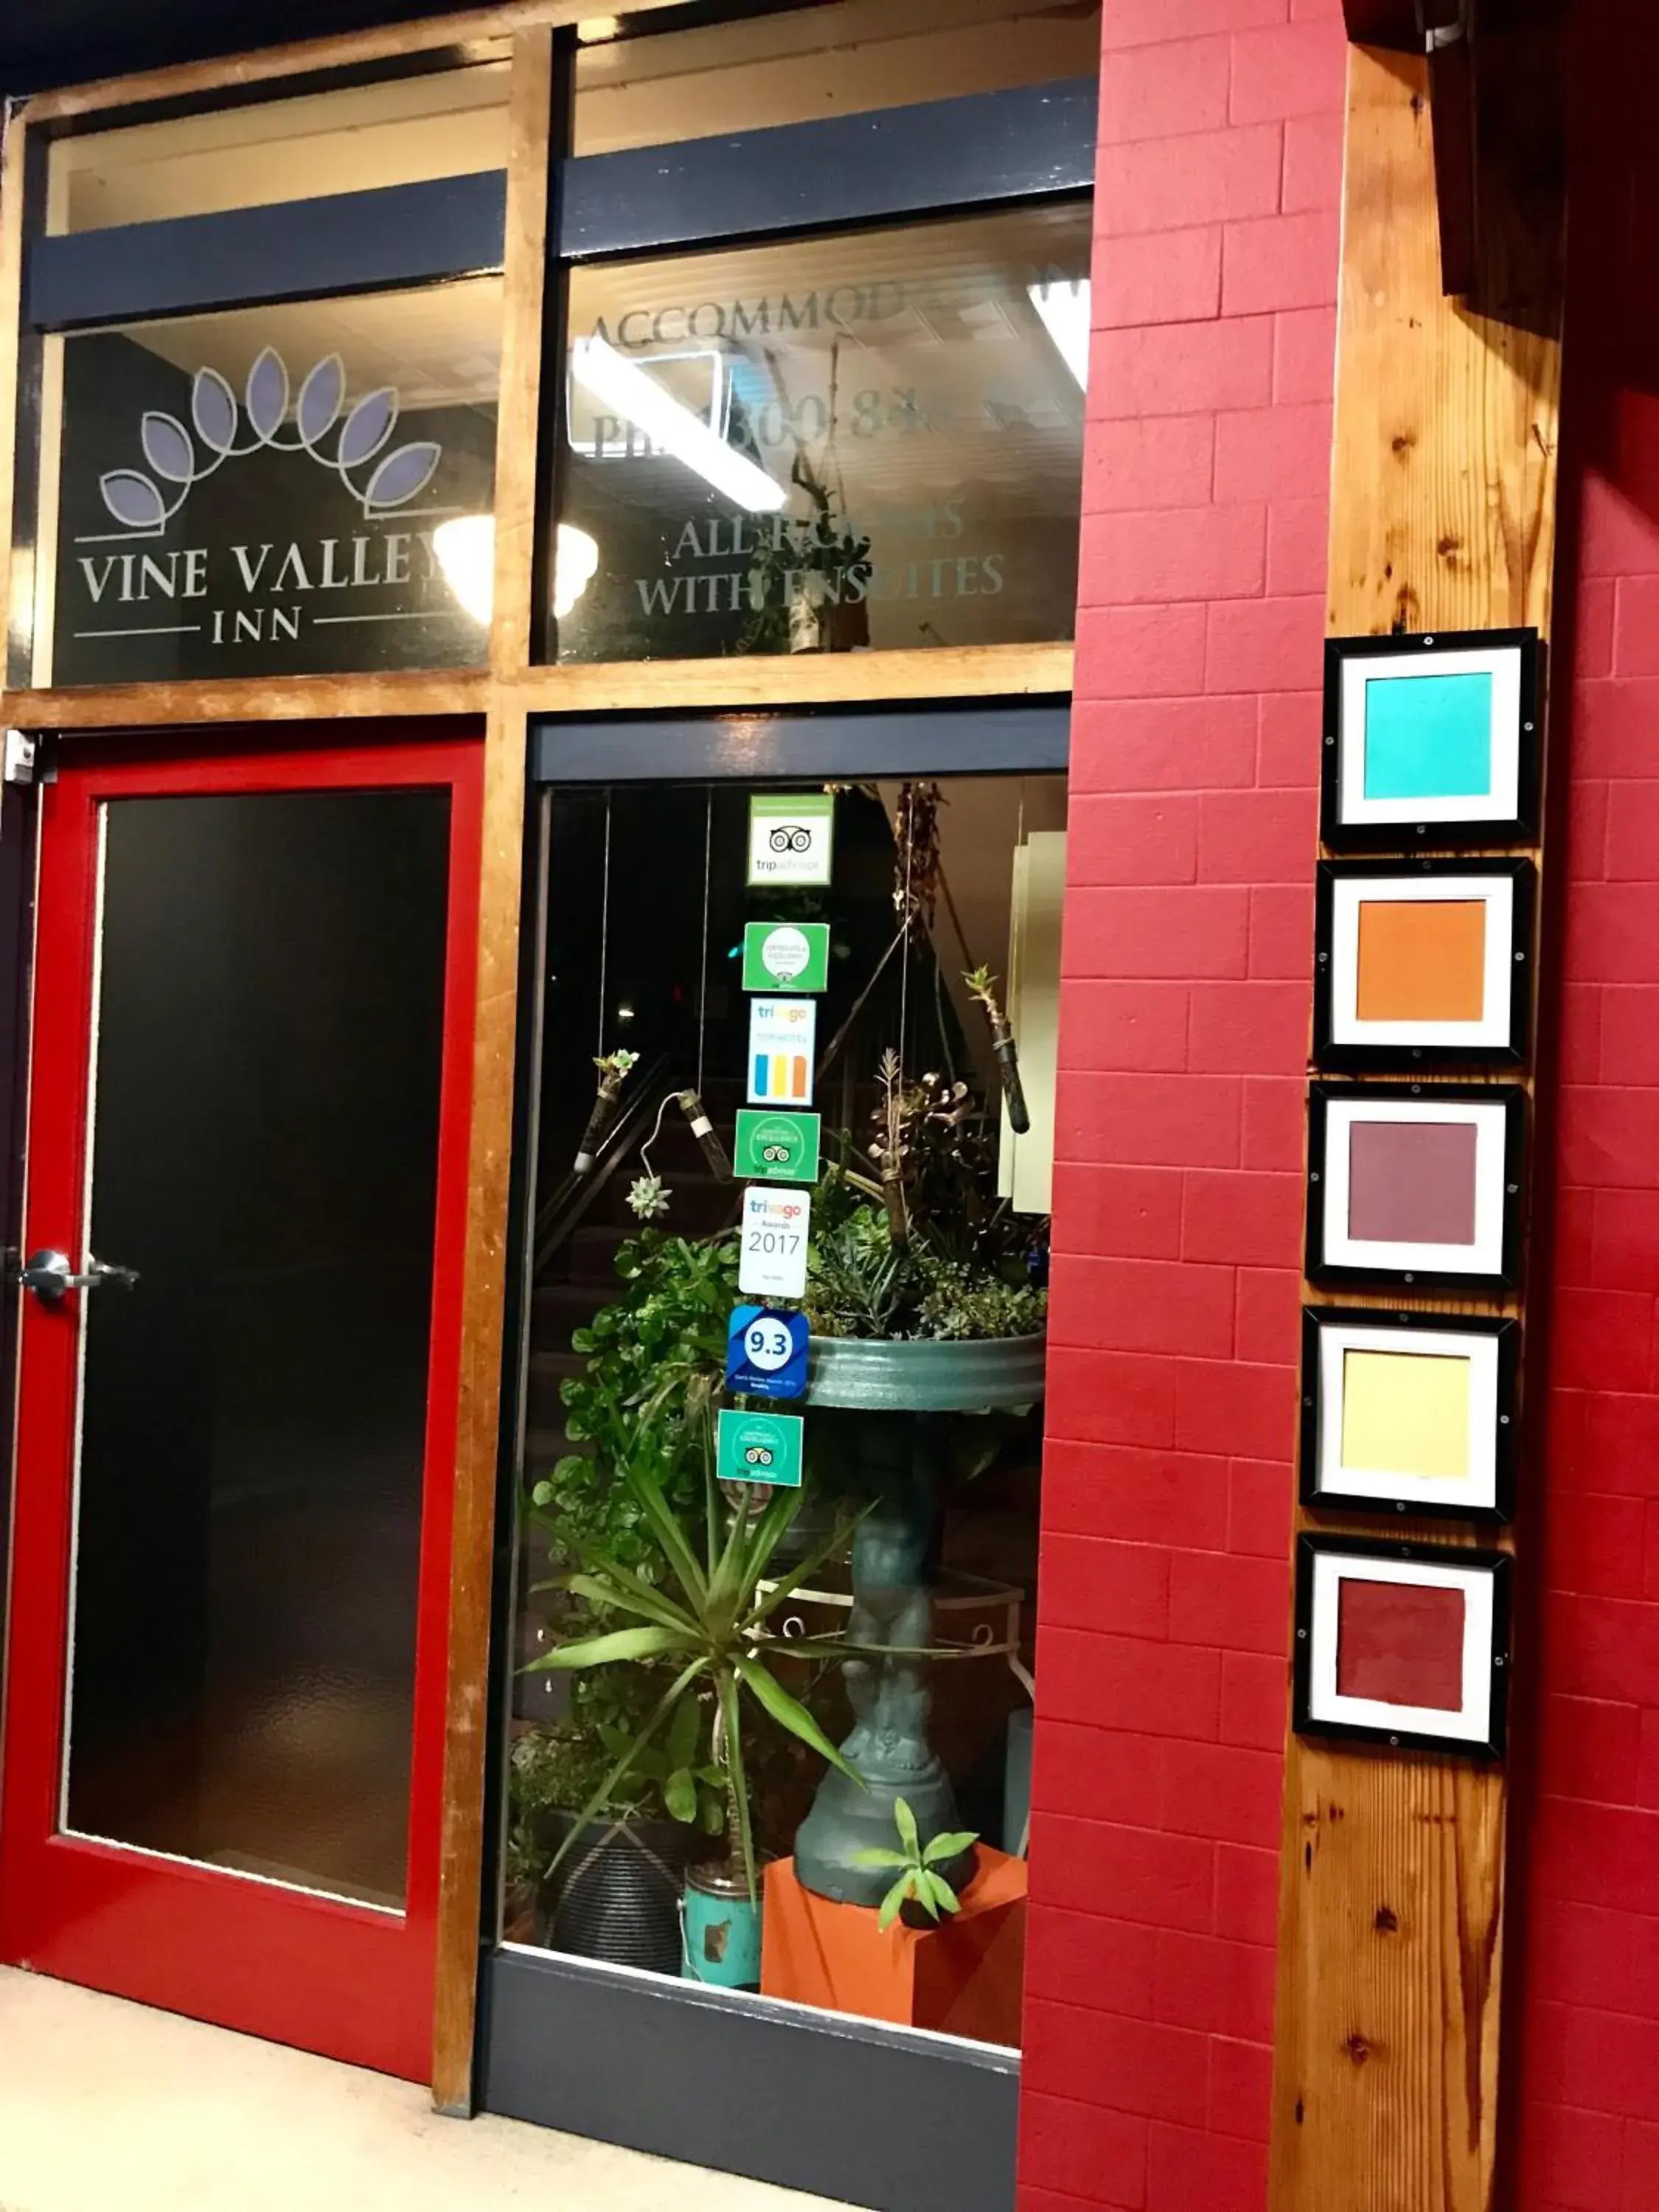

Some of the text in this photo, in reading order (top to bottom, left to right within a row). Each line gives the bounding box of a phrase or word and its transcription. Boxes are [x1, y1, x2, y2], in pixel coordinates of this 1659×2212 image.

[672, 512, 753, 560] ALL
[77, 548, 208, 602] VINE
[634, 568, 764, 617] WITH
[212, 606, 303, 644] INN
[748, 1231, 801, 1256] 2017
[751, 1330, 787, 1355] 9.3
